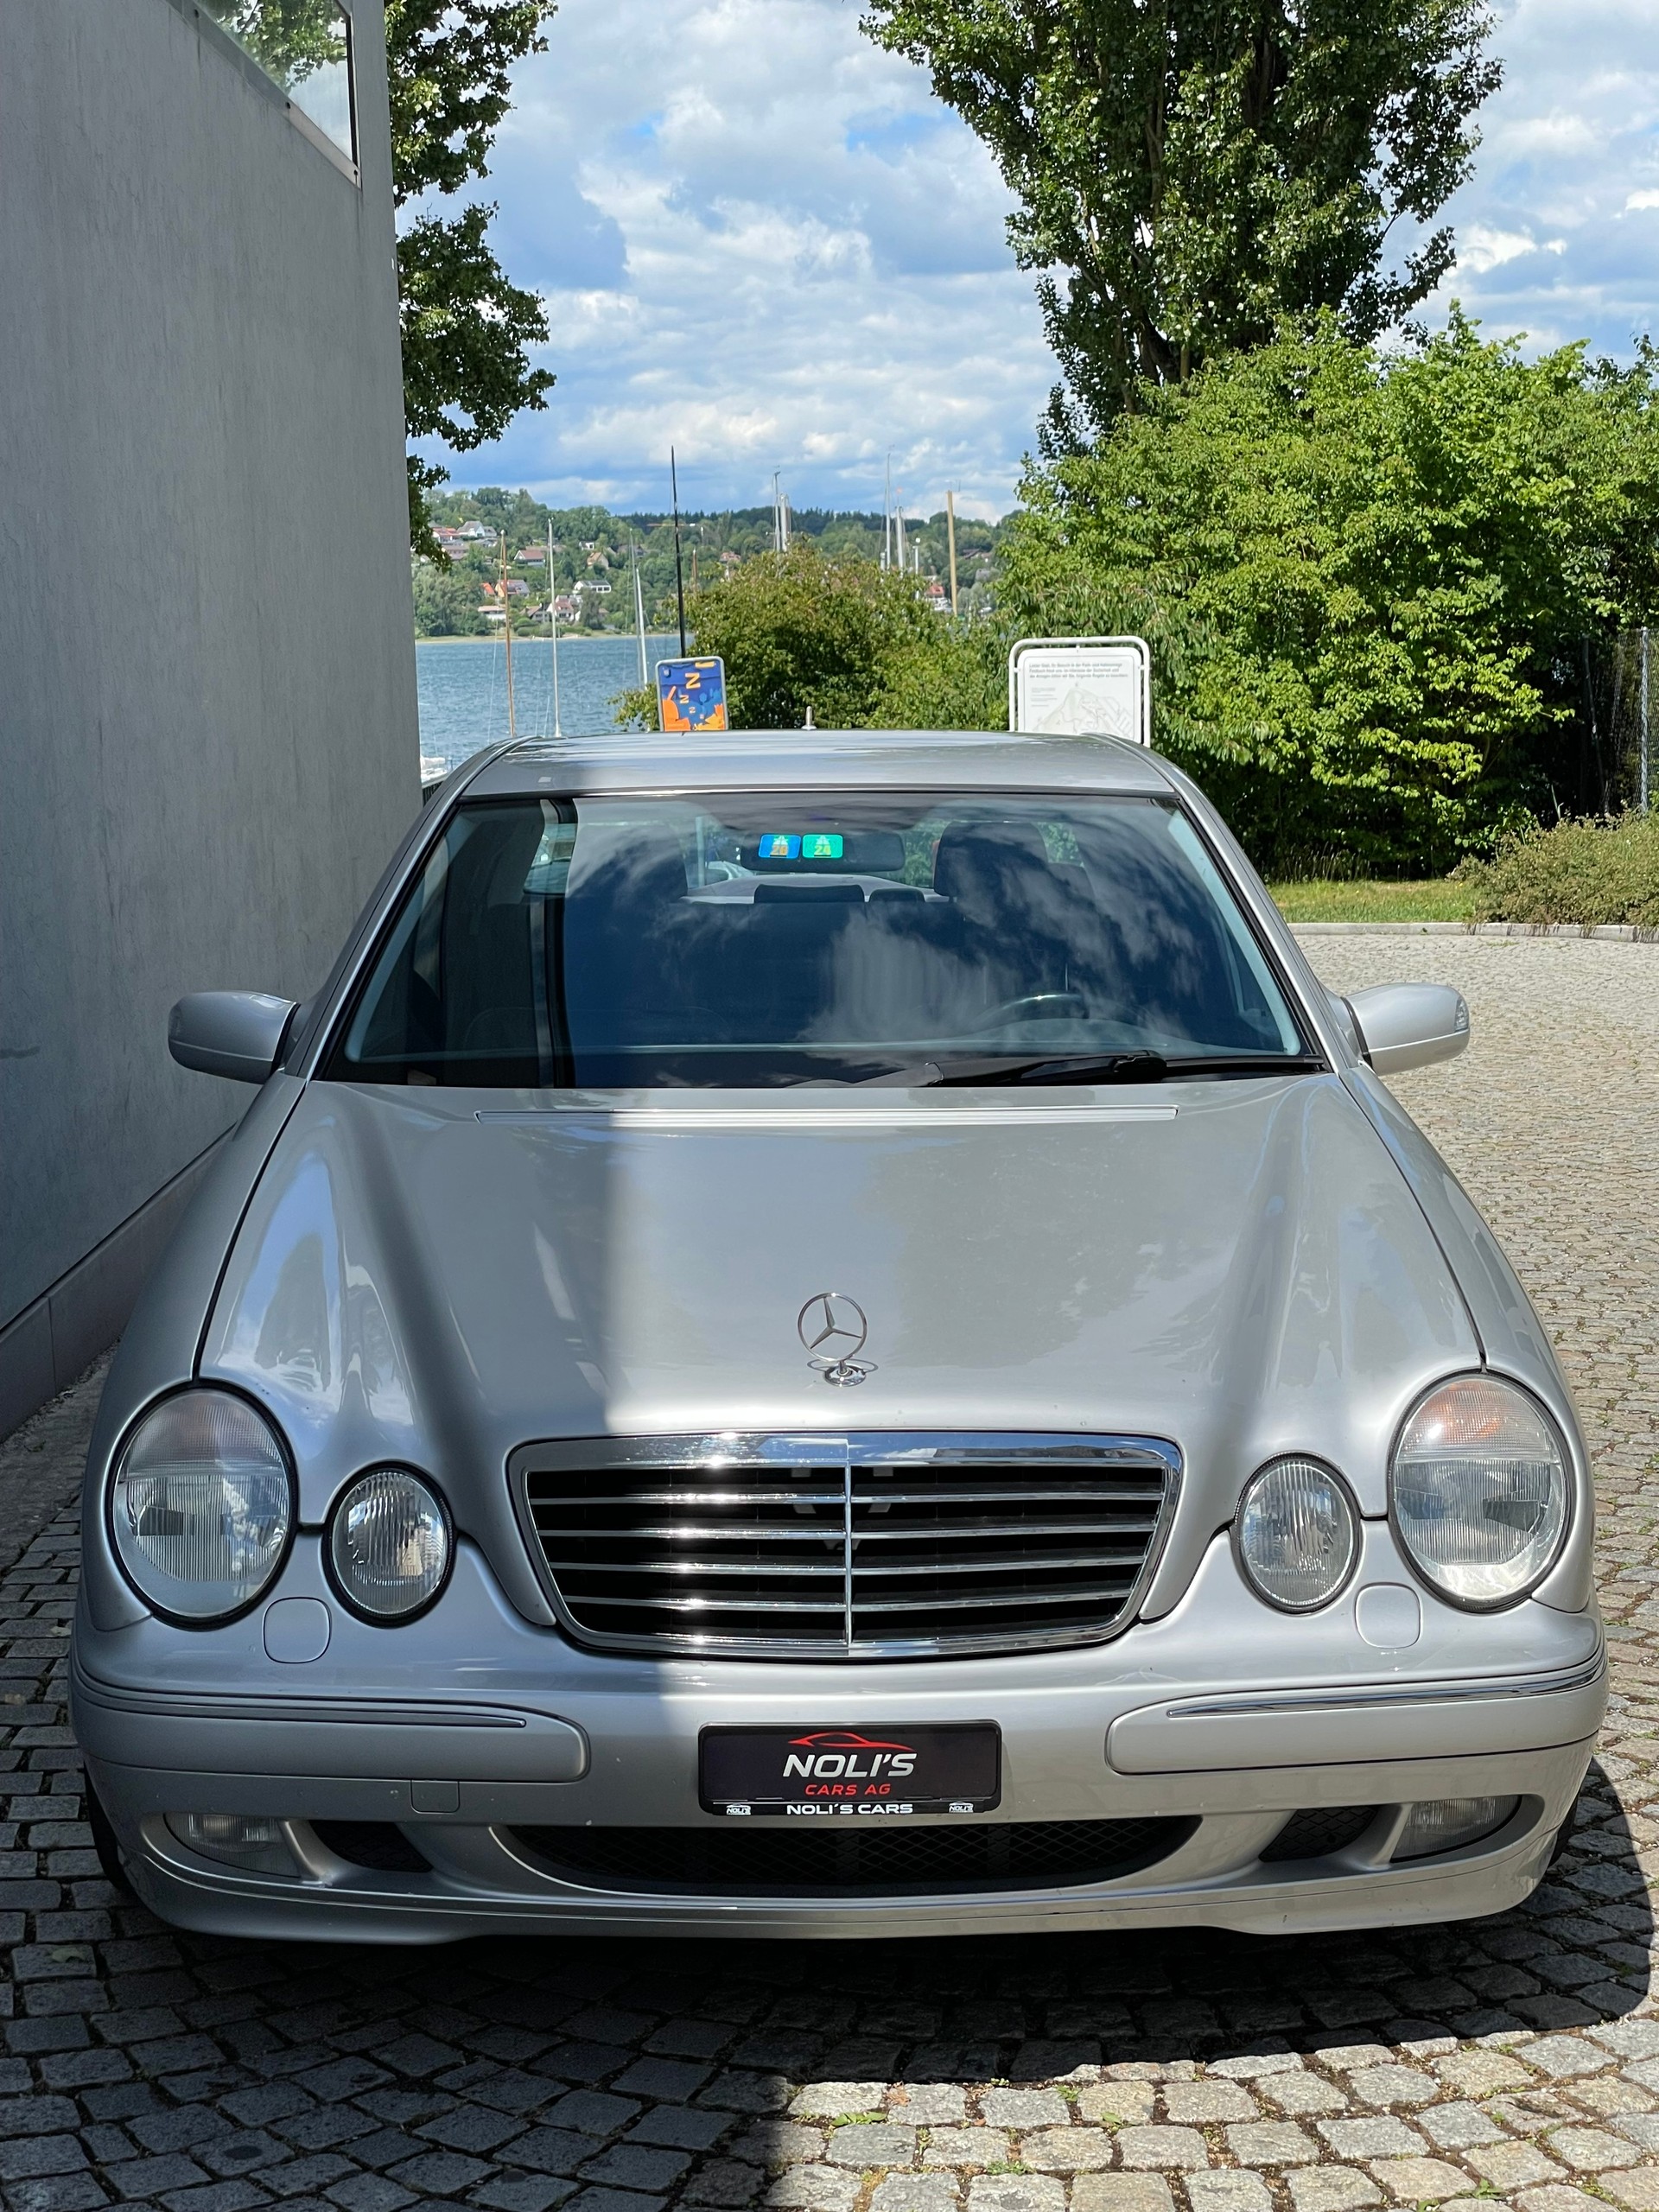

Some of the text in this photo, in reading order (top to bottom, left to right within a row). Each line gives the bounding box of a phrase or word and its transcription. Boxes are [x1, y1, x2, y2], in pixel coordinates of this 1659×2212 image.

[782, 1753, 918, 1777] NOLI'S
[805, 1783, 891, 1796] CARS AG
[857, 1803, 913, 1815] CARS
